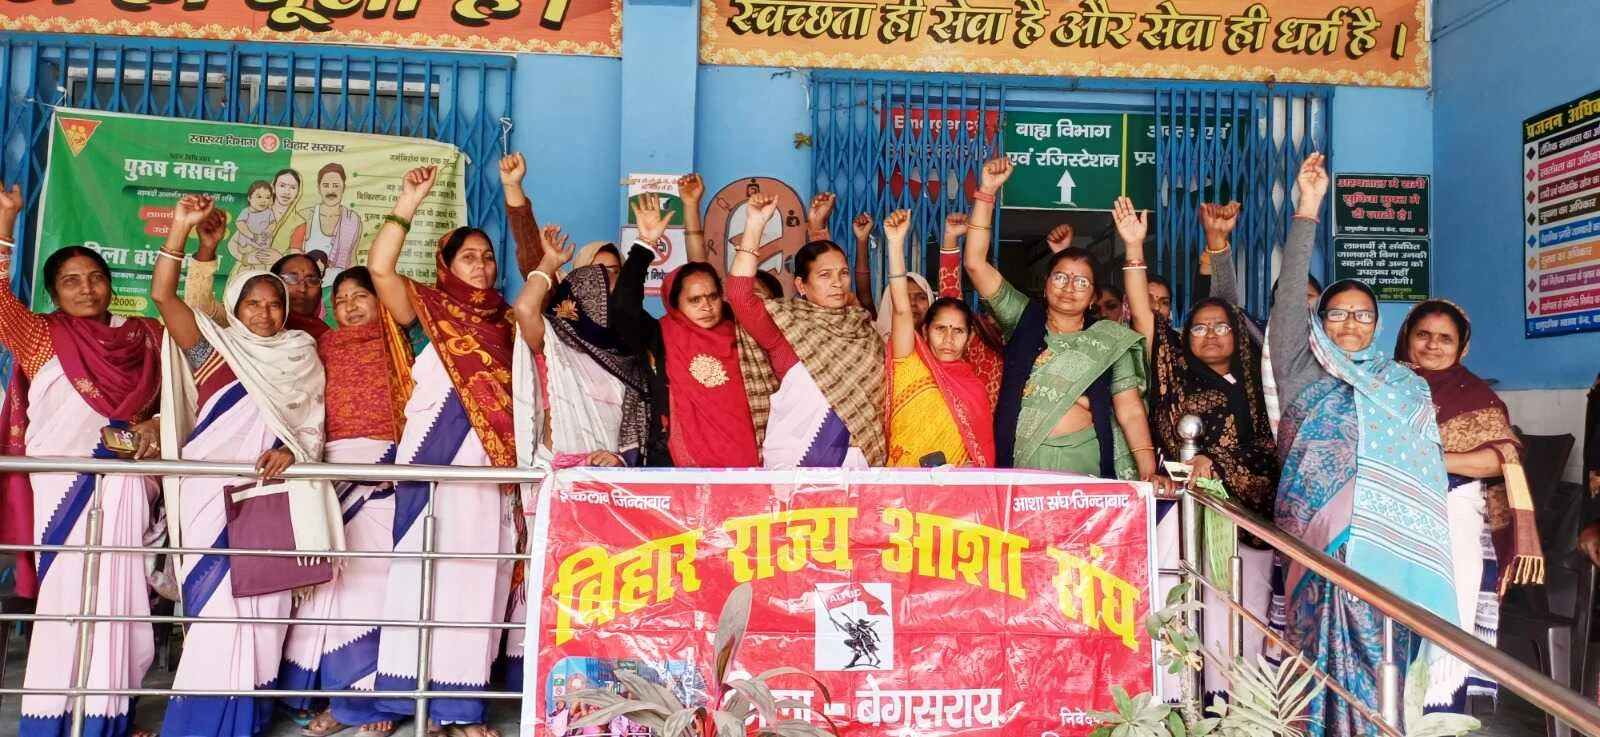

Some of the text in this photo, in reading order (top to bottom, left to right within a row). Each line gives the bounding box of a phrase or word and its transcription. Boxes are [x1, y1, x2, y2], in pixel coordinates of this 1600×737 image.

[733, 1, 877, 38] स्वच्छता
[930, 0, 1013, 42] सेवा
[1015, 0, 1051, 48] है
[1052, 0, 1135, 51] और
[1141, 2, 1221, 52] सेवा
[1222, 4, 1271, 55] ही
[1273, 7, 1344, 56] धर्म
[1345, 7, 1382, 60] है
[1056, 118, 1113, 138] विभाग
[282, 139, 345, 154] बिहार सरकार
[124, 158, 239, 182] पुरुष नसबंदी
[1012, 489, 1131, 512] आशा संघ जिन्दाबाद
[551, 505, 1143, 653] बिहार राज्य आशा संघ
